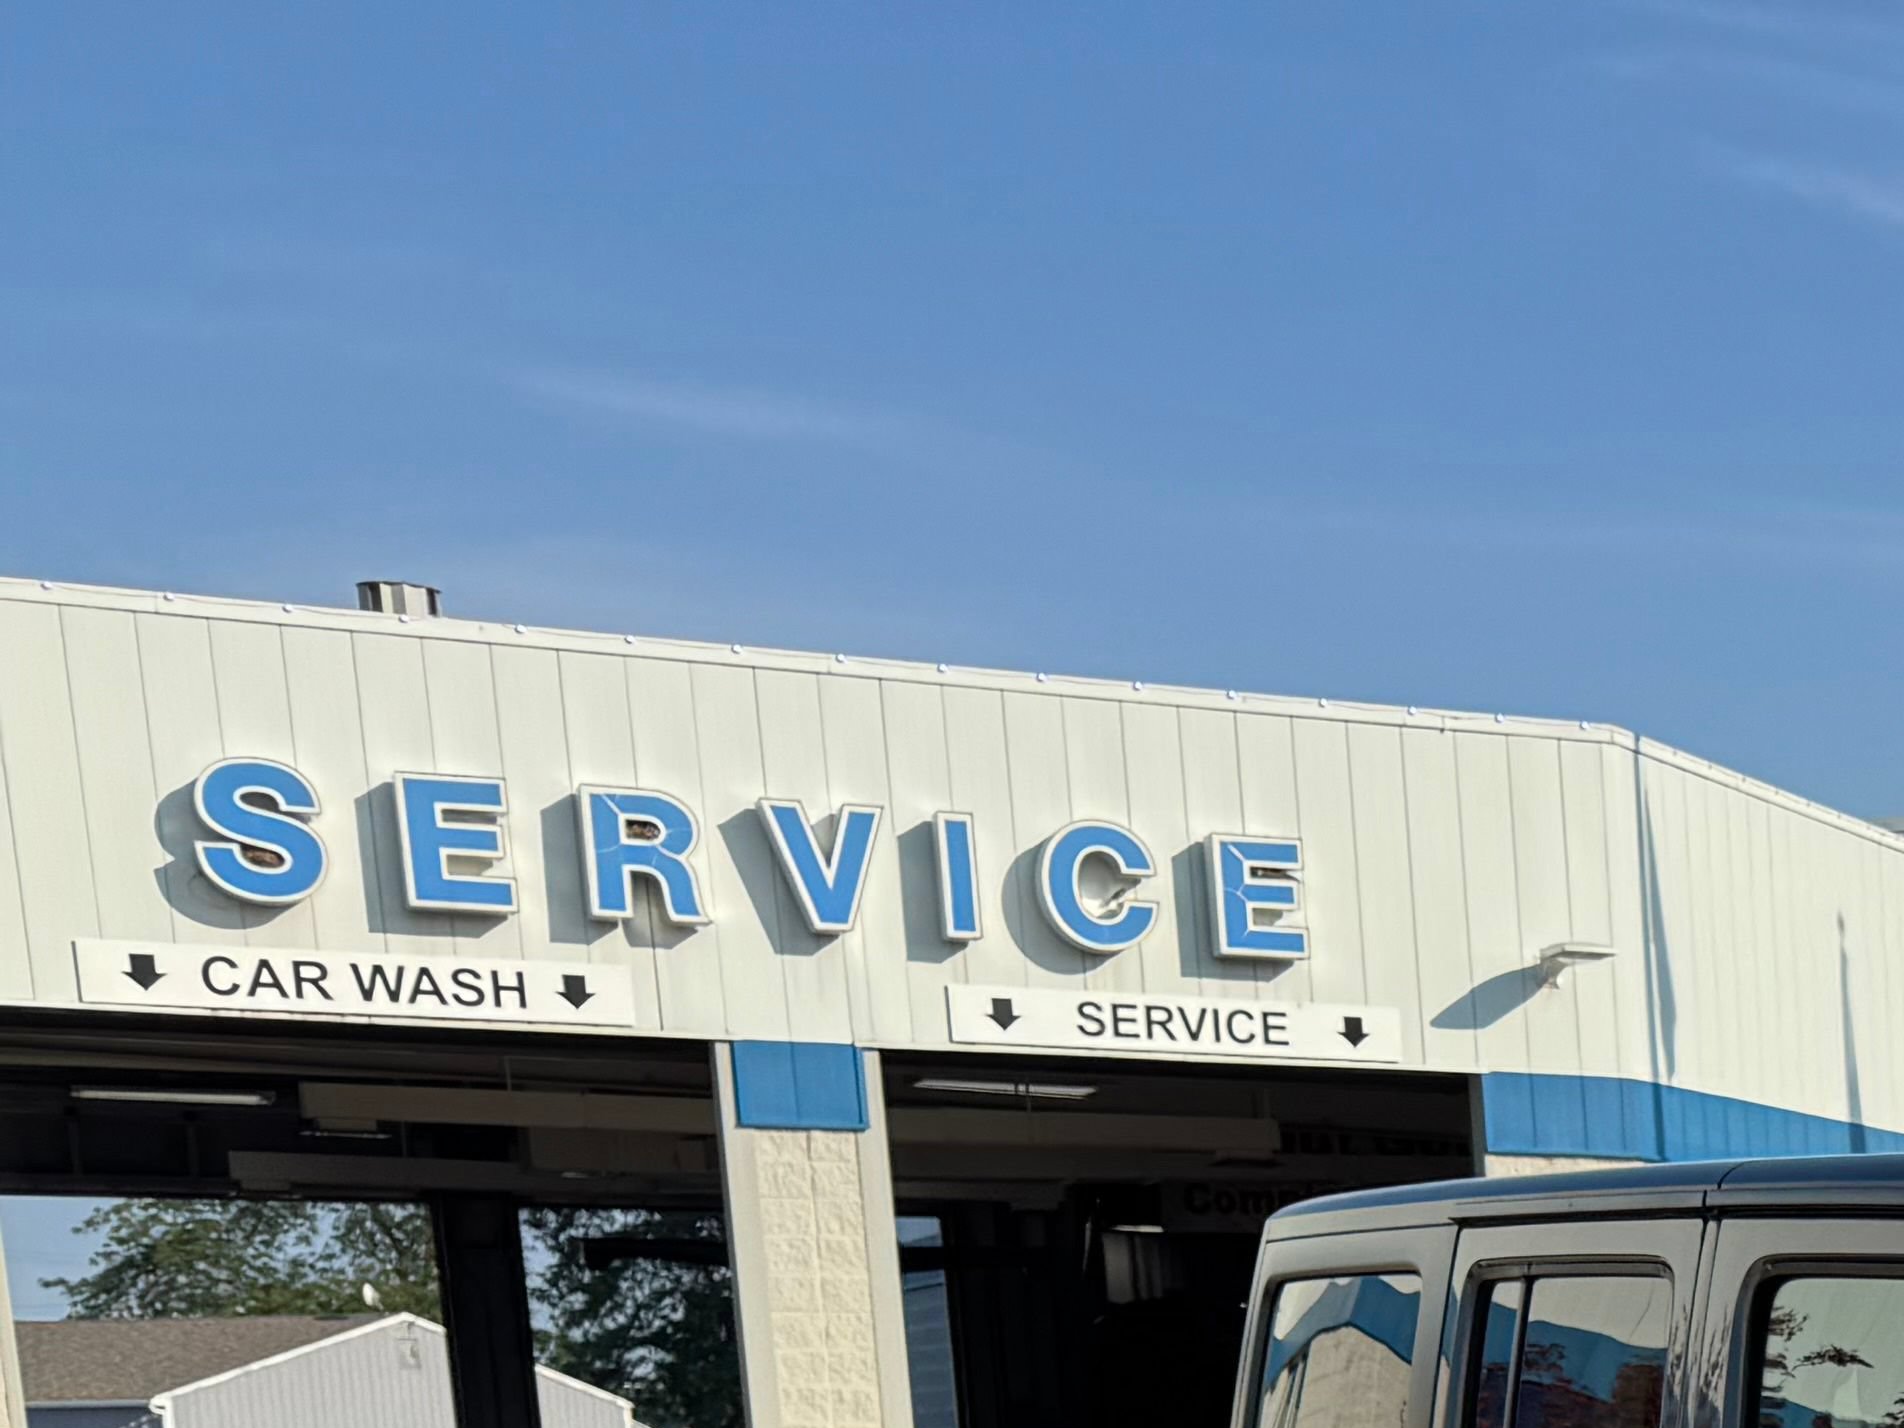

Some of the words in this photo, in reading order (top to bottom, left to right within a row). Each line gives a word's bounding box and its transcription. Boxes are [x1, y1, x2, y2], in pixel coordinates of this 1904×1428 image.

[193, 756, 1311, 961] SERVICE
[201, 955, 334, 1001] CAR
[351, 961, 527, 1009] WASH
[1076, 1000, 1290, 1046] SERVICE
